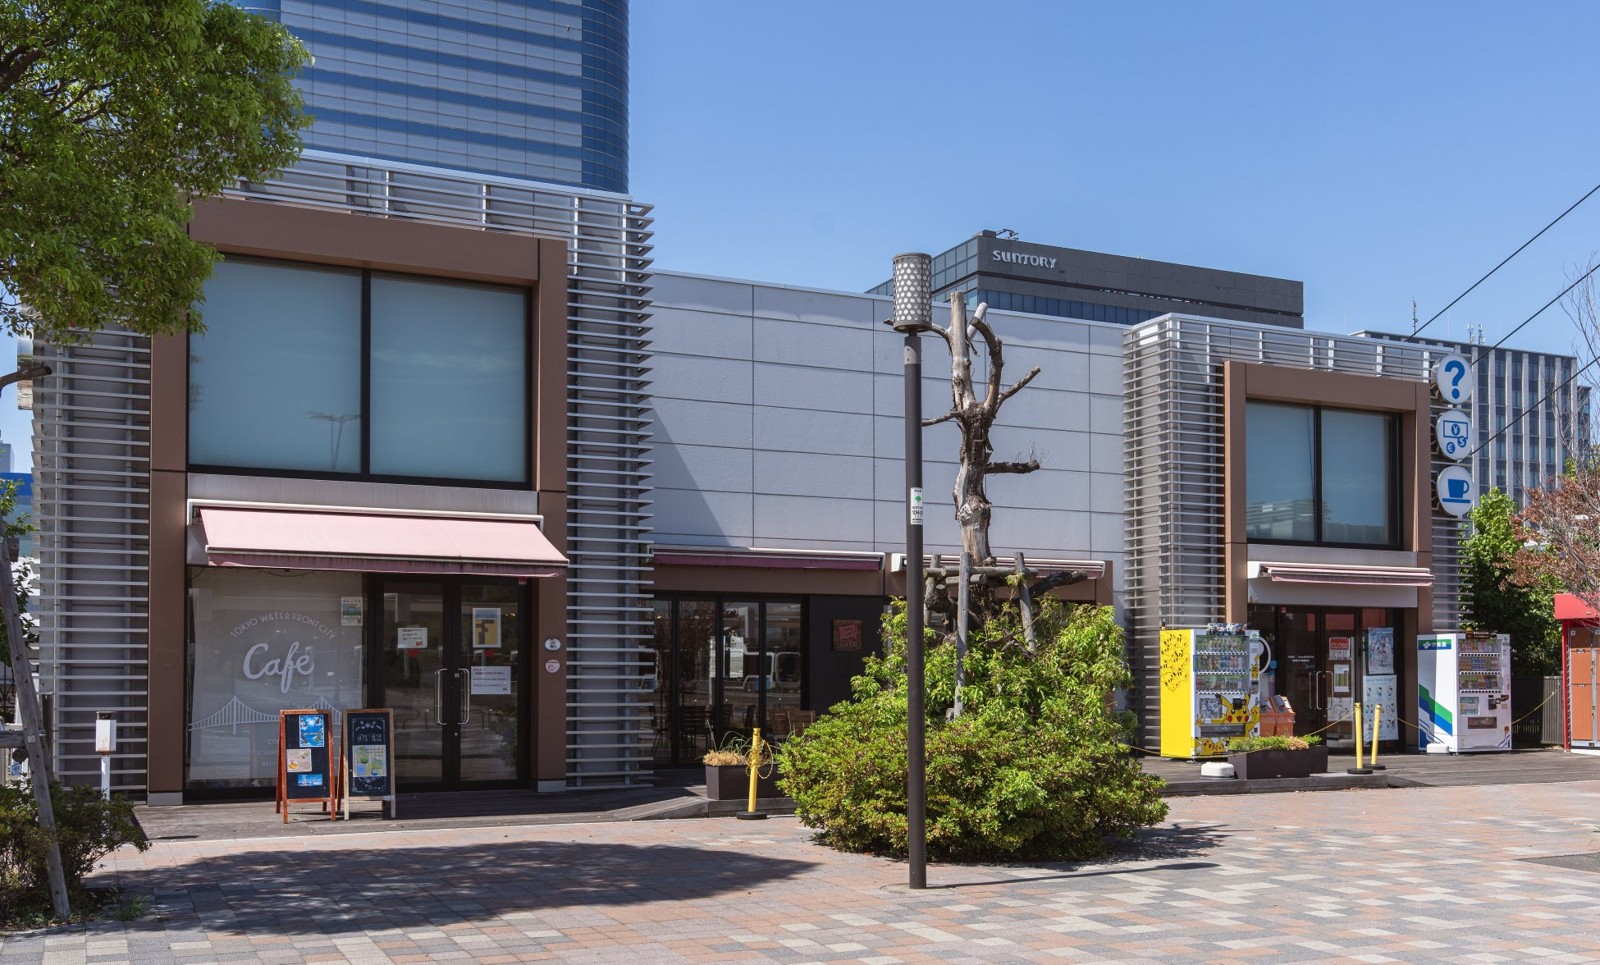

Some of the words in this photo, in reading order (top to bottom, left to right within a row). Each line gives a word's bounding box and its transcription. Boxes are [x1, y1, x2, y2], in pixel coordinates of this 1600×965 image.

[992, 250, 1057, 269] SUNTORY
[229, 617, 258, 639] TOKYO
[259, 611, 290, 623] WATER
[292, 612, 320, 628] FRONT
[318, 624, 337, 640] CITY
